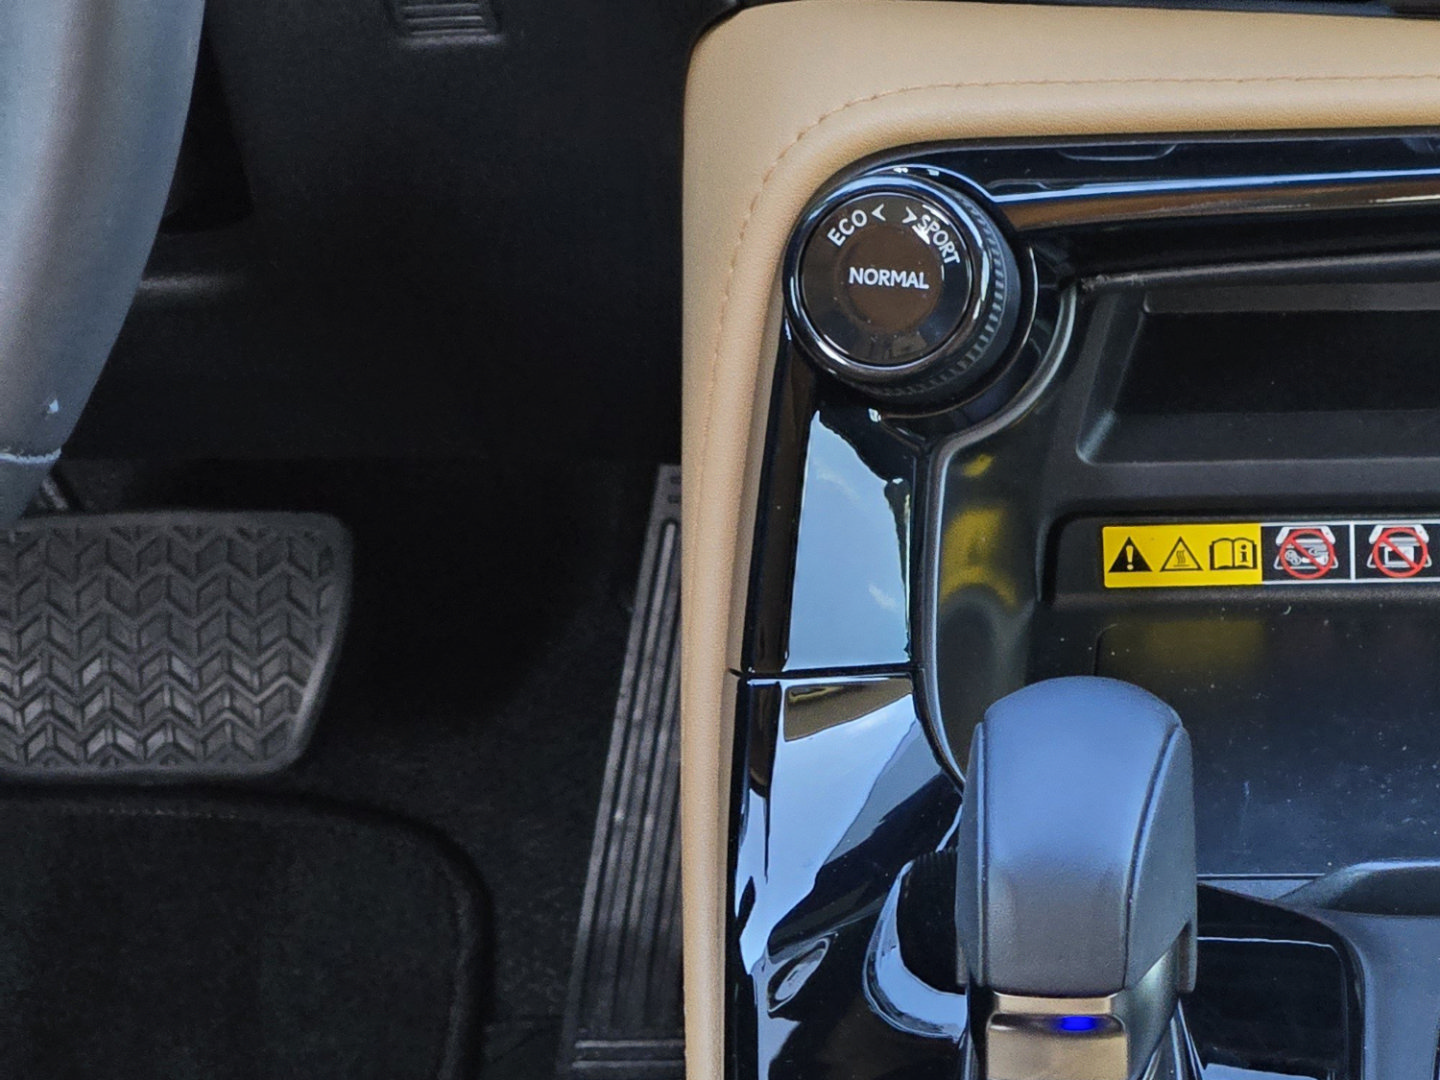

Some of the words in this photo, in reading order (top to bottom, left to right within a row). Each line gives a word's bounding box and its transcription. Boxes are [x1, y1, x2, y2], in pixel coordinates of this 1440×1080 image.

[827, 209, 868, 247] ECO
[917, 214, 960, 264] SPORT
[848, 266, 930, 290] NORMAL
